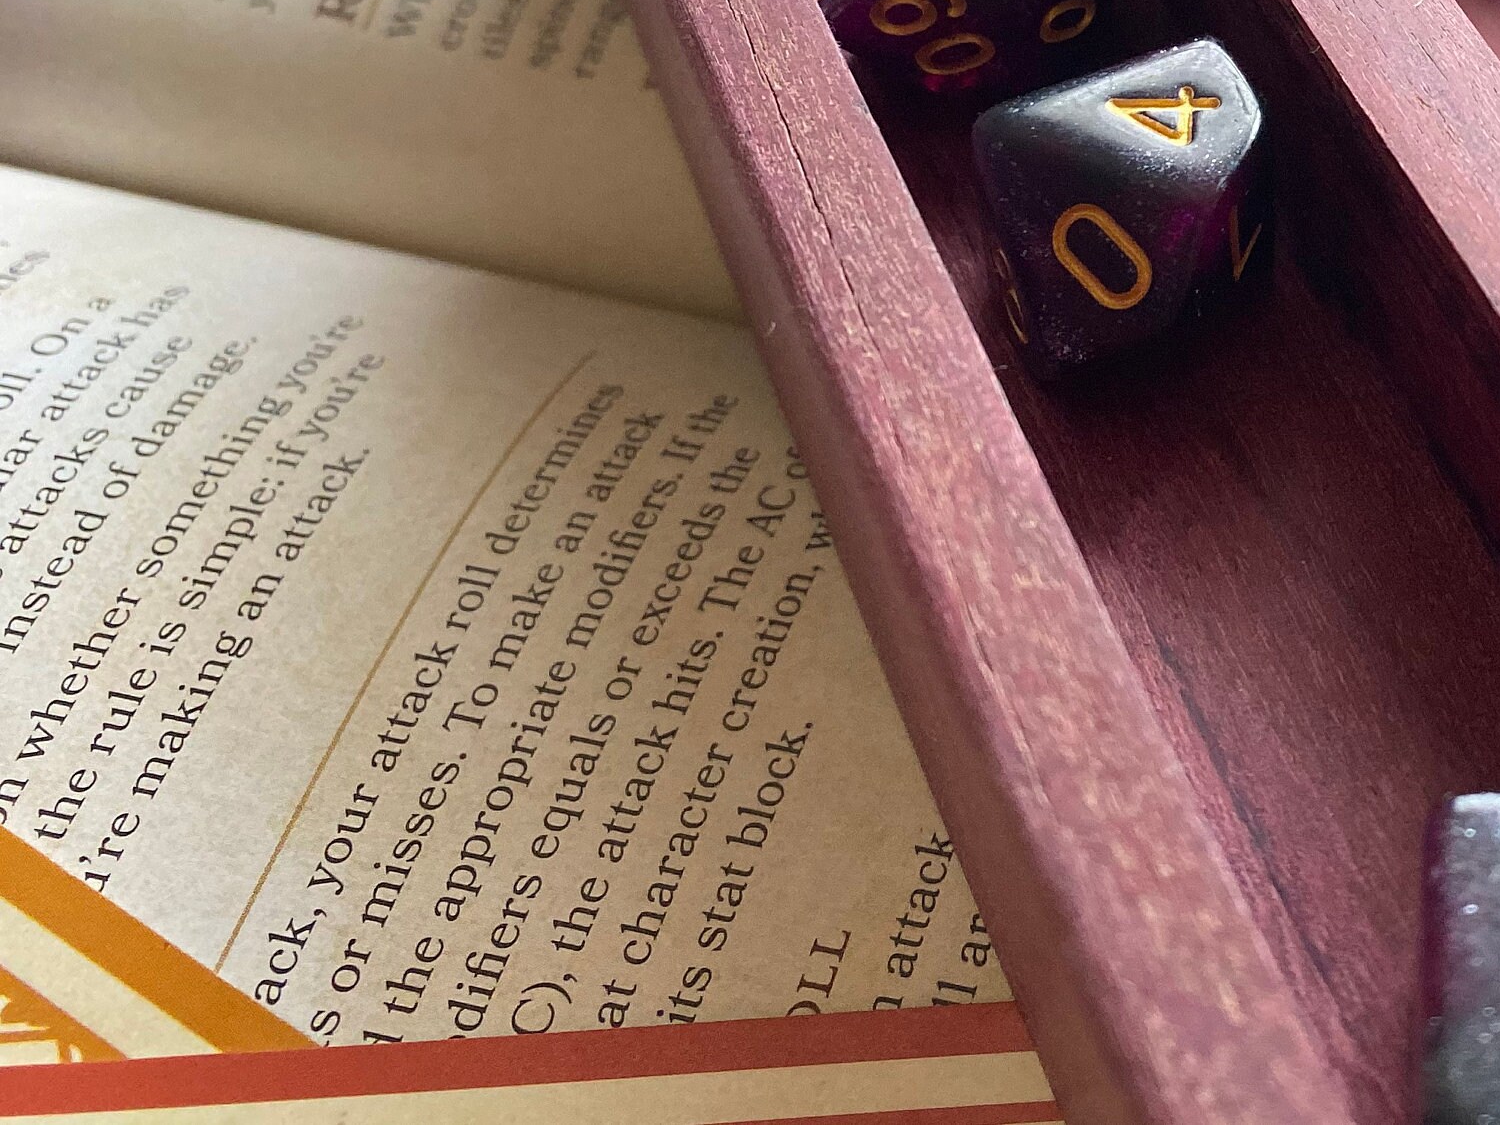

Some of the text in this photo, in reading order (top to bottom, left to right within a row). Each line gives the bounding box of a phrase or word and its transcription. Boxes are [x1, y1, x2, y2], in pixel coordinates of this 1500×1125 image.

[1052, 203, 1152, 310] 0
[1105, 85, 1221, 147] 4
[0, 335, 193, 555] attacks cause
[31, 317, 92, 356] On
[88, 296, 113, 313] a
[41, 332, 139, 421] attack
[121, 285, 190, 328] has
[103, 461, 142, 499] of
[131, 336, 258, 458] damage.
[16, 587, 142, 761] whether
[136, 395, 293, 578] something
[34, 769, 97, 839] the
[90, 668, 158, 757] rule
[139, 622, 187, 656] is
[179, 477, 285, 610] simple:
[266, 440, 308, 469] if
[132, 630, 253, 799] making
[237, 574, 285, 621] an
[275, 449, 371, 562] attack.
[255, 383, 624, 1005] ack, your attack roll determines
[331, 938, 372, 993] or
[362, 752, 468, 928] misses.
[442, 682, 499, 732] To
[489, 563, 564, 671] make
[554, 510, 598, 554] an
[586, 410, 666, 502] attack
[384, 937, 444, 1015] the
[434, 660, 577, 922] appropriate
[566, 473, 684, 650] modifiers.
[660, 435, 705, 463] If
[687, 393, 740, 434] the
[448, 446, 760, 1039] difiers equals or exceeds the
[551, 877, 609, 951] the
[598, 725, 679, 863] attack
[652, 631, 724, 715] hits.
[698, 543, 764, 612] The
[746, 484, 796, 538] AC
[598, 979, 637, 1028] at
[621, 742, 733, 964] character
[722, 565, 825, 732] creation,
[657, 722, 814, 1023] its stat block.
[887, 832, 954, 978] attack
